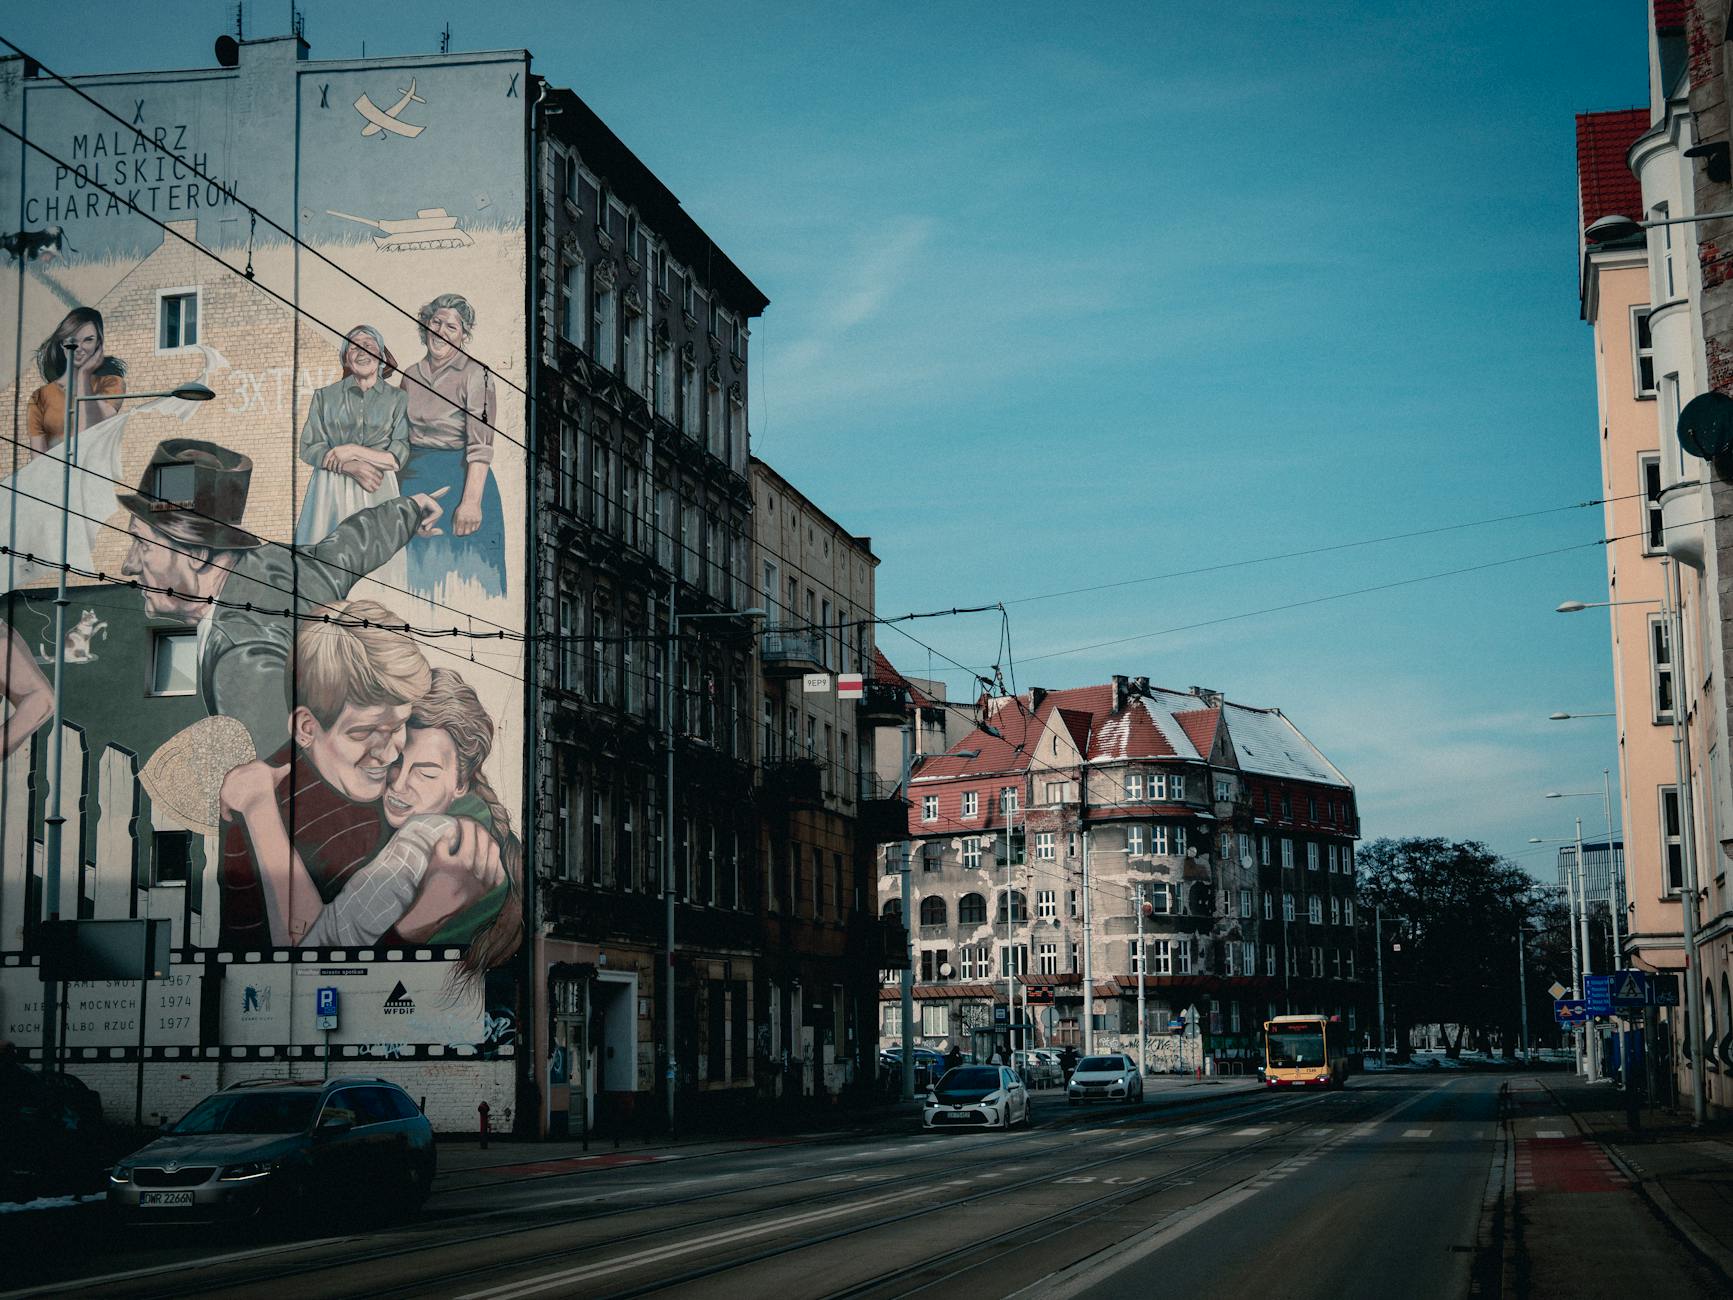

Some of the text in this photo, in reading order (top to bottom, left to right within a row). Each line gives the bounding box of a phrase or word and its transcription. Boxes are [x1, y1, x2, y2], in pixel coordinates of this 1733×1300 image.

[73, 125, 188, 160] MALARZ
[55, 152, 208, 191] POLSKICH
[26, 176, 238, 224] CHARAKTERÓW
[160, 974, 192, 987] 1967
[80, 1000, 136, 1010] MOCNYCH
[159, 996, 191, 1008] 1974
[321, 990, 333, 1008] P
[10, 1023, 45, 1033] KOCH
[159, 1017, 191, 1030] 1977
[145, 1192, 192, 1204] DWR 2266N
